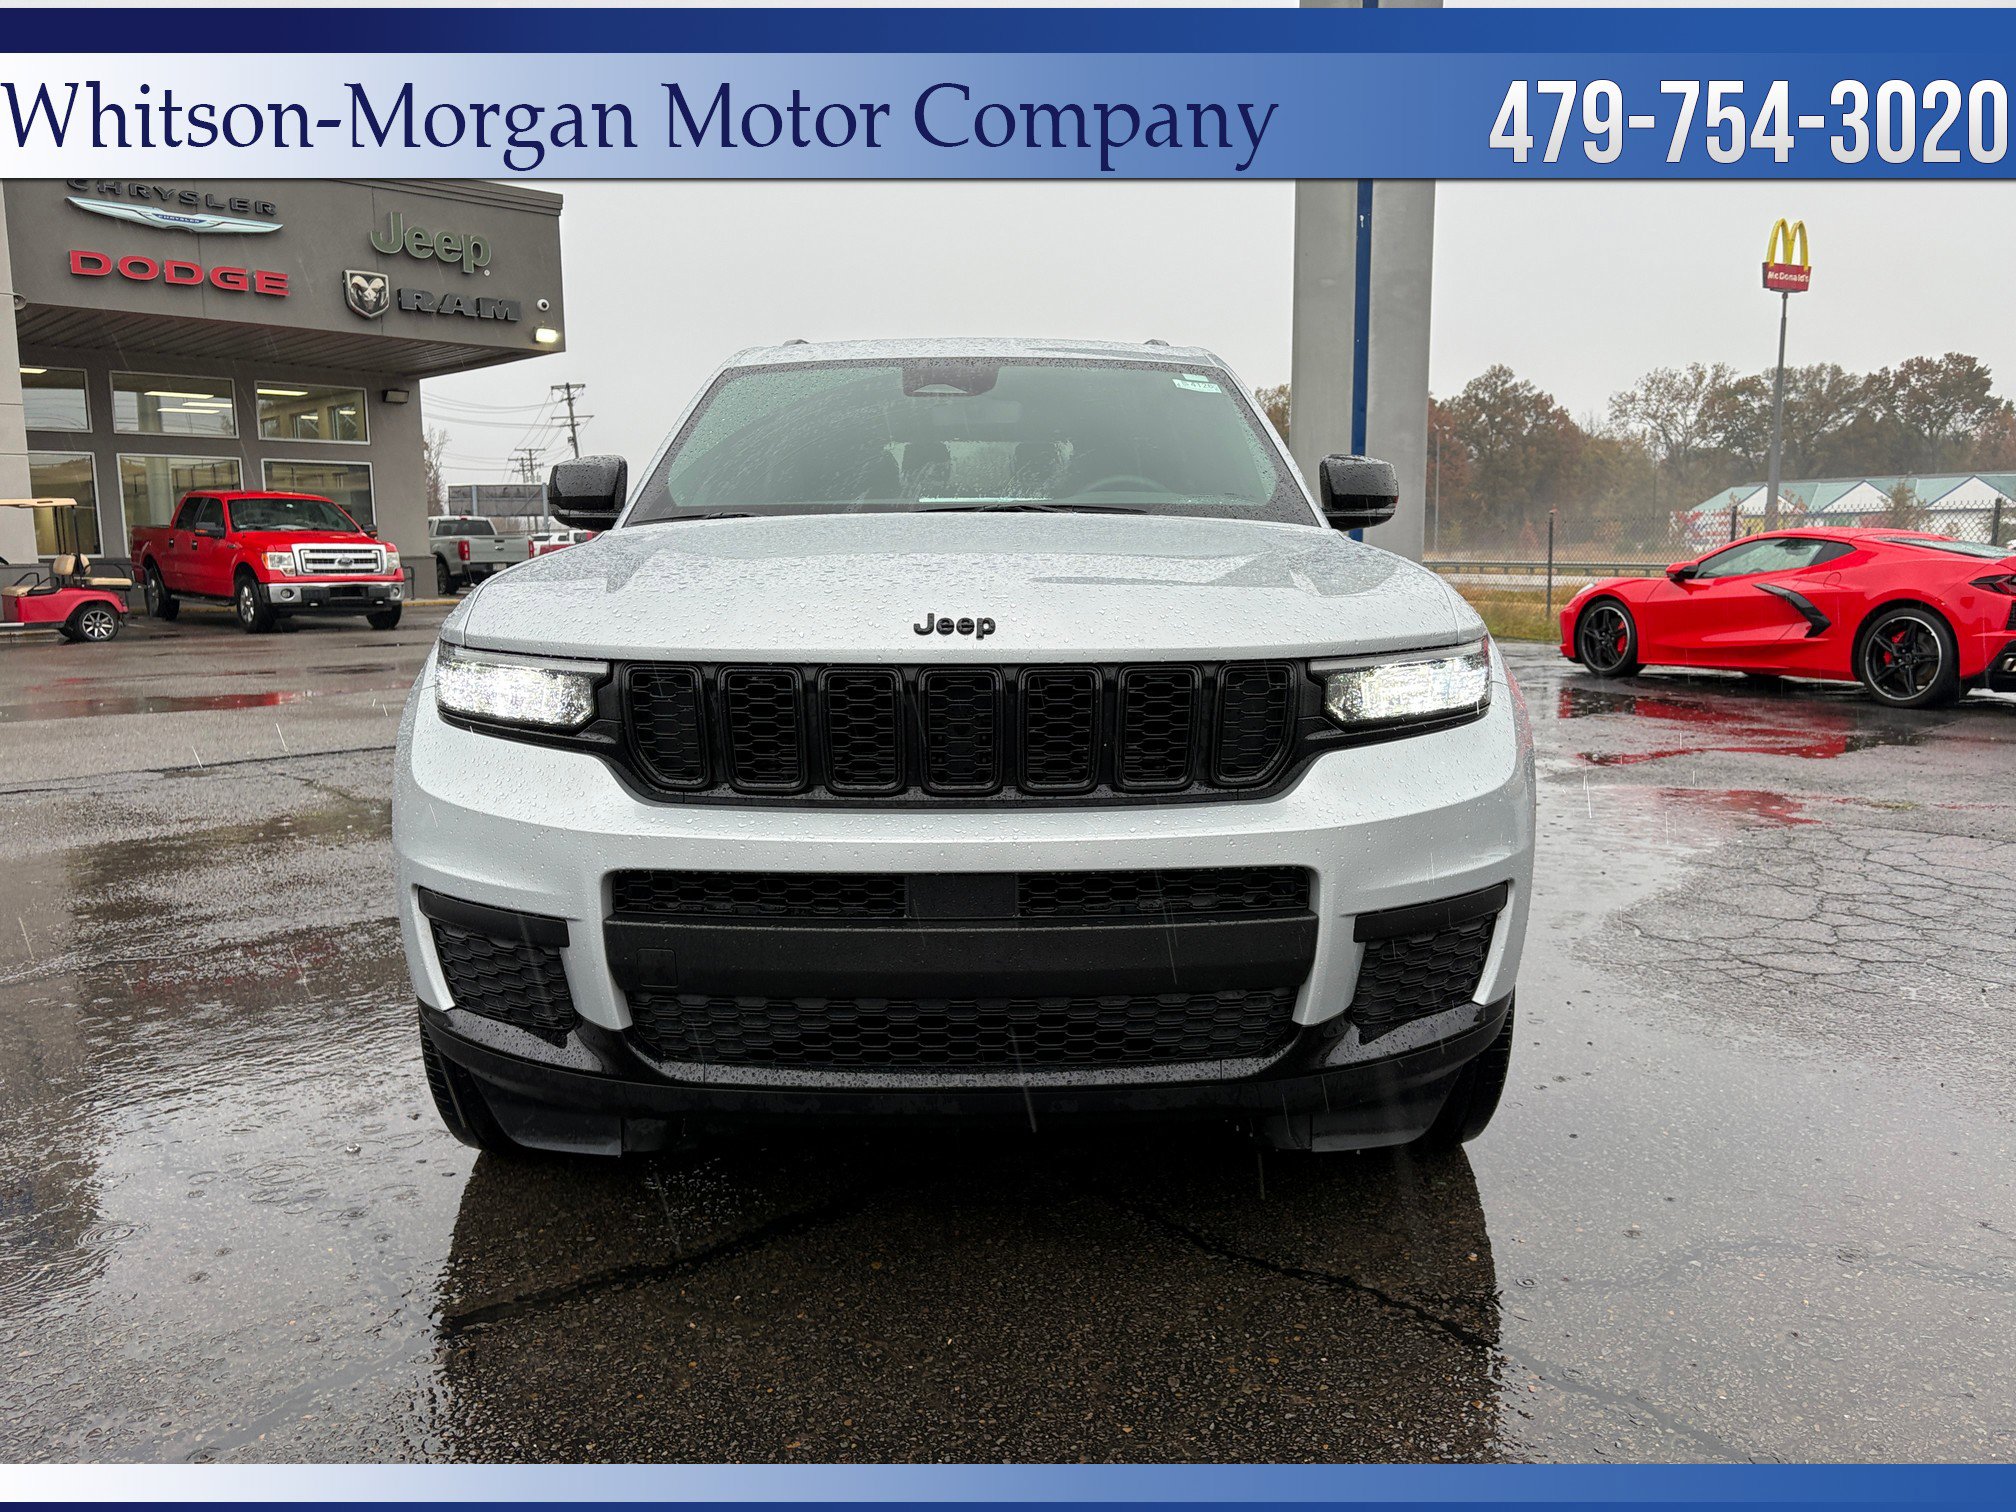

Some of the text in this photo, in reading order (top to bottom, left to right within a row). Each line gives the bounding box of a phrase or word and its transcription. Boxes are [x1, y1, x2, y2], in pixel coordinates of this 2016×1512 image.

[67, 179, 277, 215] CHRYSLER
[370, 211, 491, 274] Jeep
[69, 250, 290, 297] DODGE
[1767, 271, 1809, 283] McDonald's
[397, 287, 522, 322] RAM
[913, 612, 996, 640] Jeep
